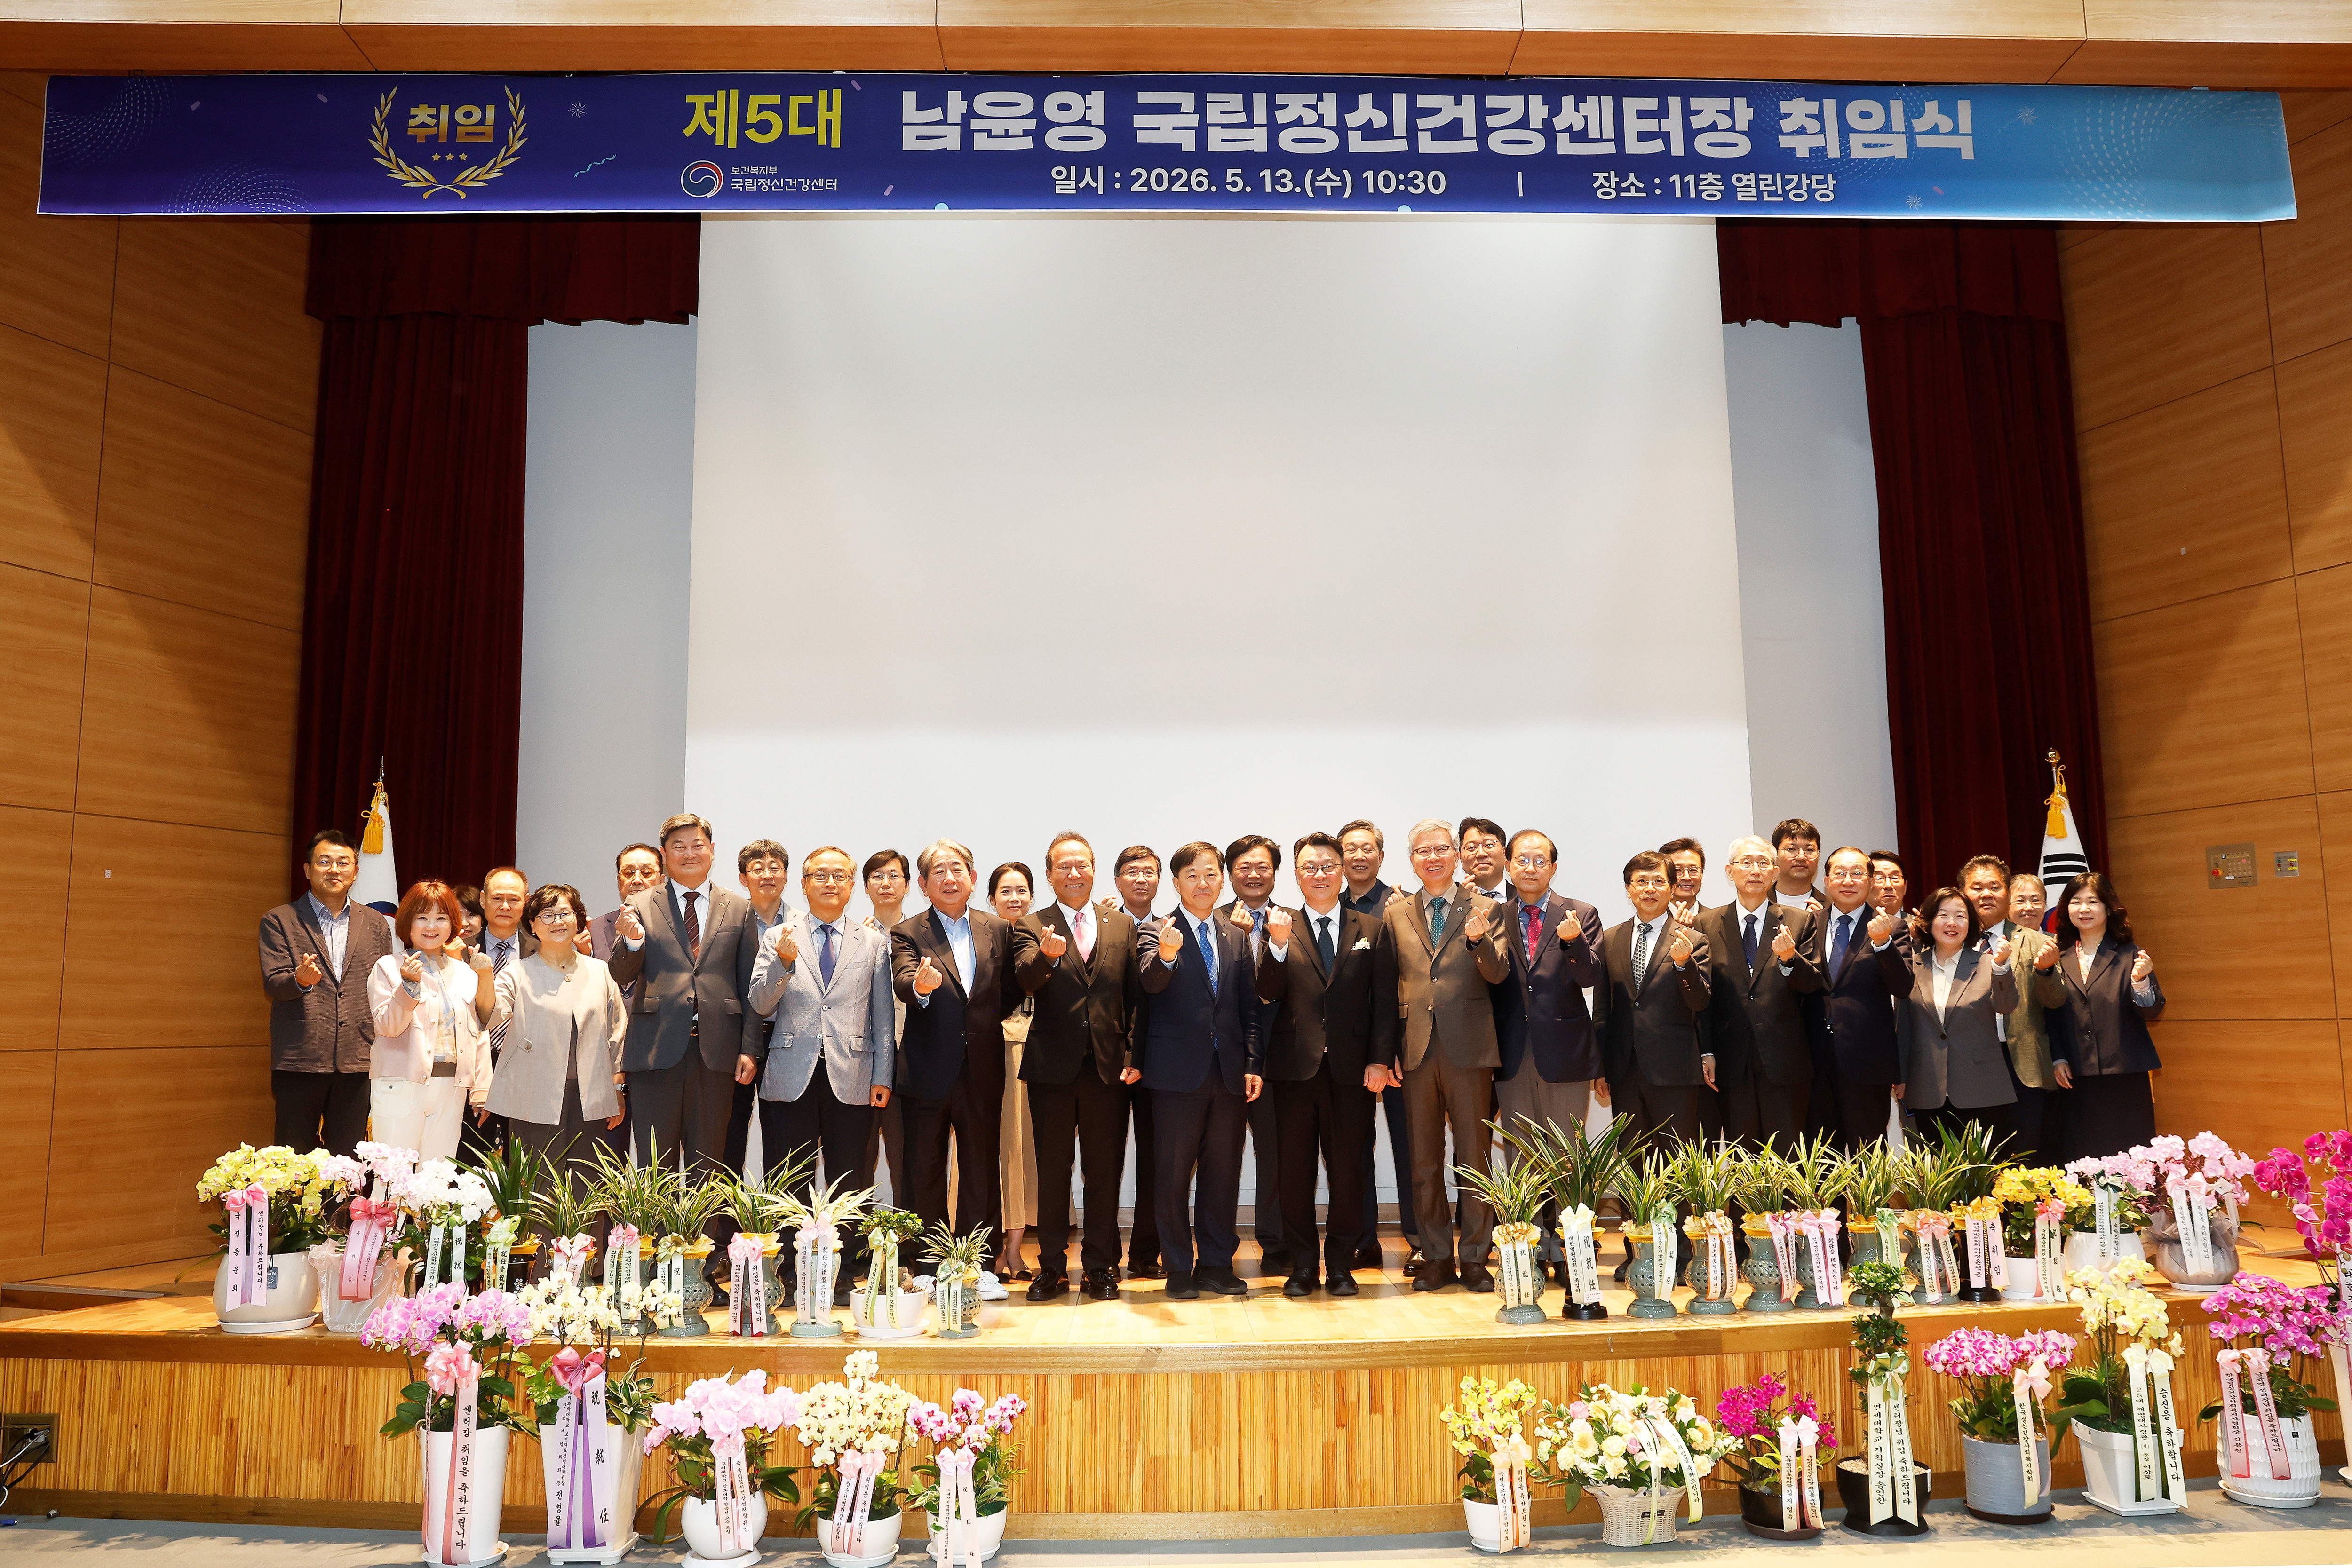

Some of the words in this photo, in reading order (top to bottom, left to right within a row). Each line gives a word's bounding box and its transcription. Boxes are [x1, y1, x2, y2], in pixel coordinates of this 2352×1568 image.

[407, 104, 495, 143] 취임
[683, 89, 842, 149] 제5대
[902, 90, 1107, 152] 남윤영
[1133, 91, 1754, 159] 국립정신건강센터장
[1779, 97, 1975, 160] 취임식
[731, 166, 778, 176] 보건복지부
[731, 178, 837, 192] 국립정신건강센터
[1050, 165, 1104, 195] 일시
[1130, 167, 1215, 193] 2026.
[1226, 169, 1252, 193] 5.
[1259, 168, 1353, 198] 13.(수)
[1362, 169, 1446, 195] 10:30
[1592, 170, 1645, 199] 장소
[1669, 173, 1725, 201] 11층
[1732, 173, 1837, 203] 열린강당
[1568, 1235, 1577, 1267] 대한병원협회
[1583, 1235, 1596, 1291] 祝就任
[1520, 1249, 1530, 1298] 祝就任
[754, 1289, 763, 1323] 축하합니다
[461, 1405, 472, 1438] 센터장
[1873, 1403, 1883, 1442] 연세대학교
[1892, 1403, 1903, 1435] 센터장님
[2159, 1388, 2171, 1421] 승진을
[459, 1444, 470, 1477] 취임을
[591, 1390, 609, 1524] 祝就任
[1874, 1446, 1886, 1479] 기획실장
[1896, 1438, 1906, 1454] 취임
[2164, 1427, 2181, 1482] 축하합니다
[736, 1468, 748, 1519] 국립정신건강센터장
[742, 1520, 748, 1532] 취임
[839, 1478, 851, 1520] 립춘천병원장
[1686, 1465, 1701, 1503] 축하드립니다
[1875, 1481, 1887, 1505] 송인한
[1899, 1457, 1912, 1505] 축하드립니다
[455, 1482, 469, 1550] 축하드립니다
[554, 1490, 563, 1527] 전병율
[856, 1500, 867, 1543] 축하드립니다
[1519, 1492, 1528, 1535] 축하드립니다
